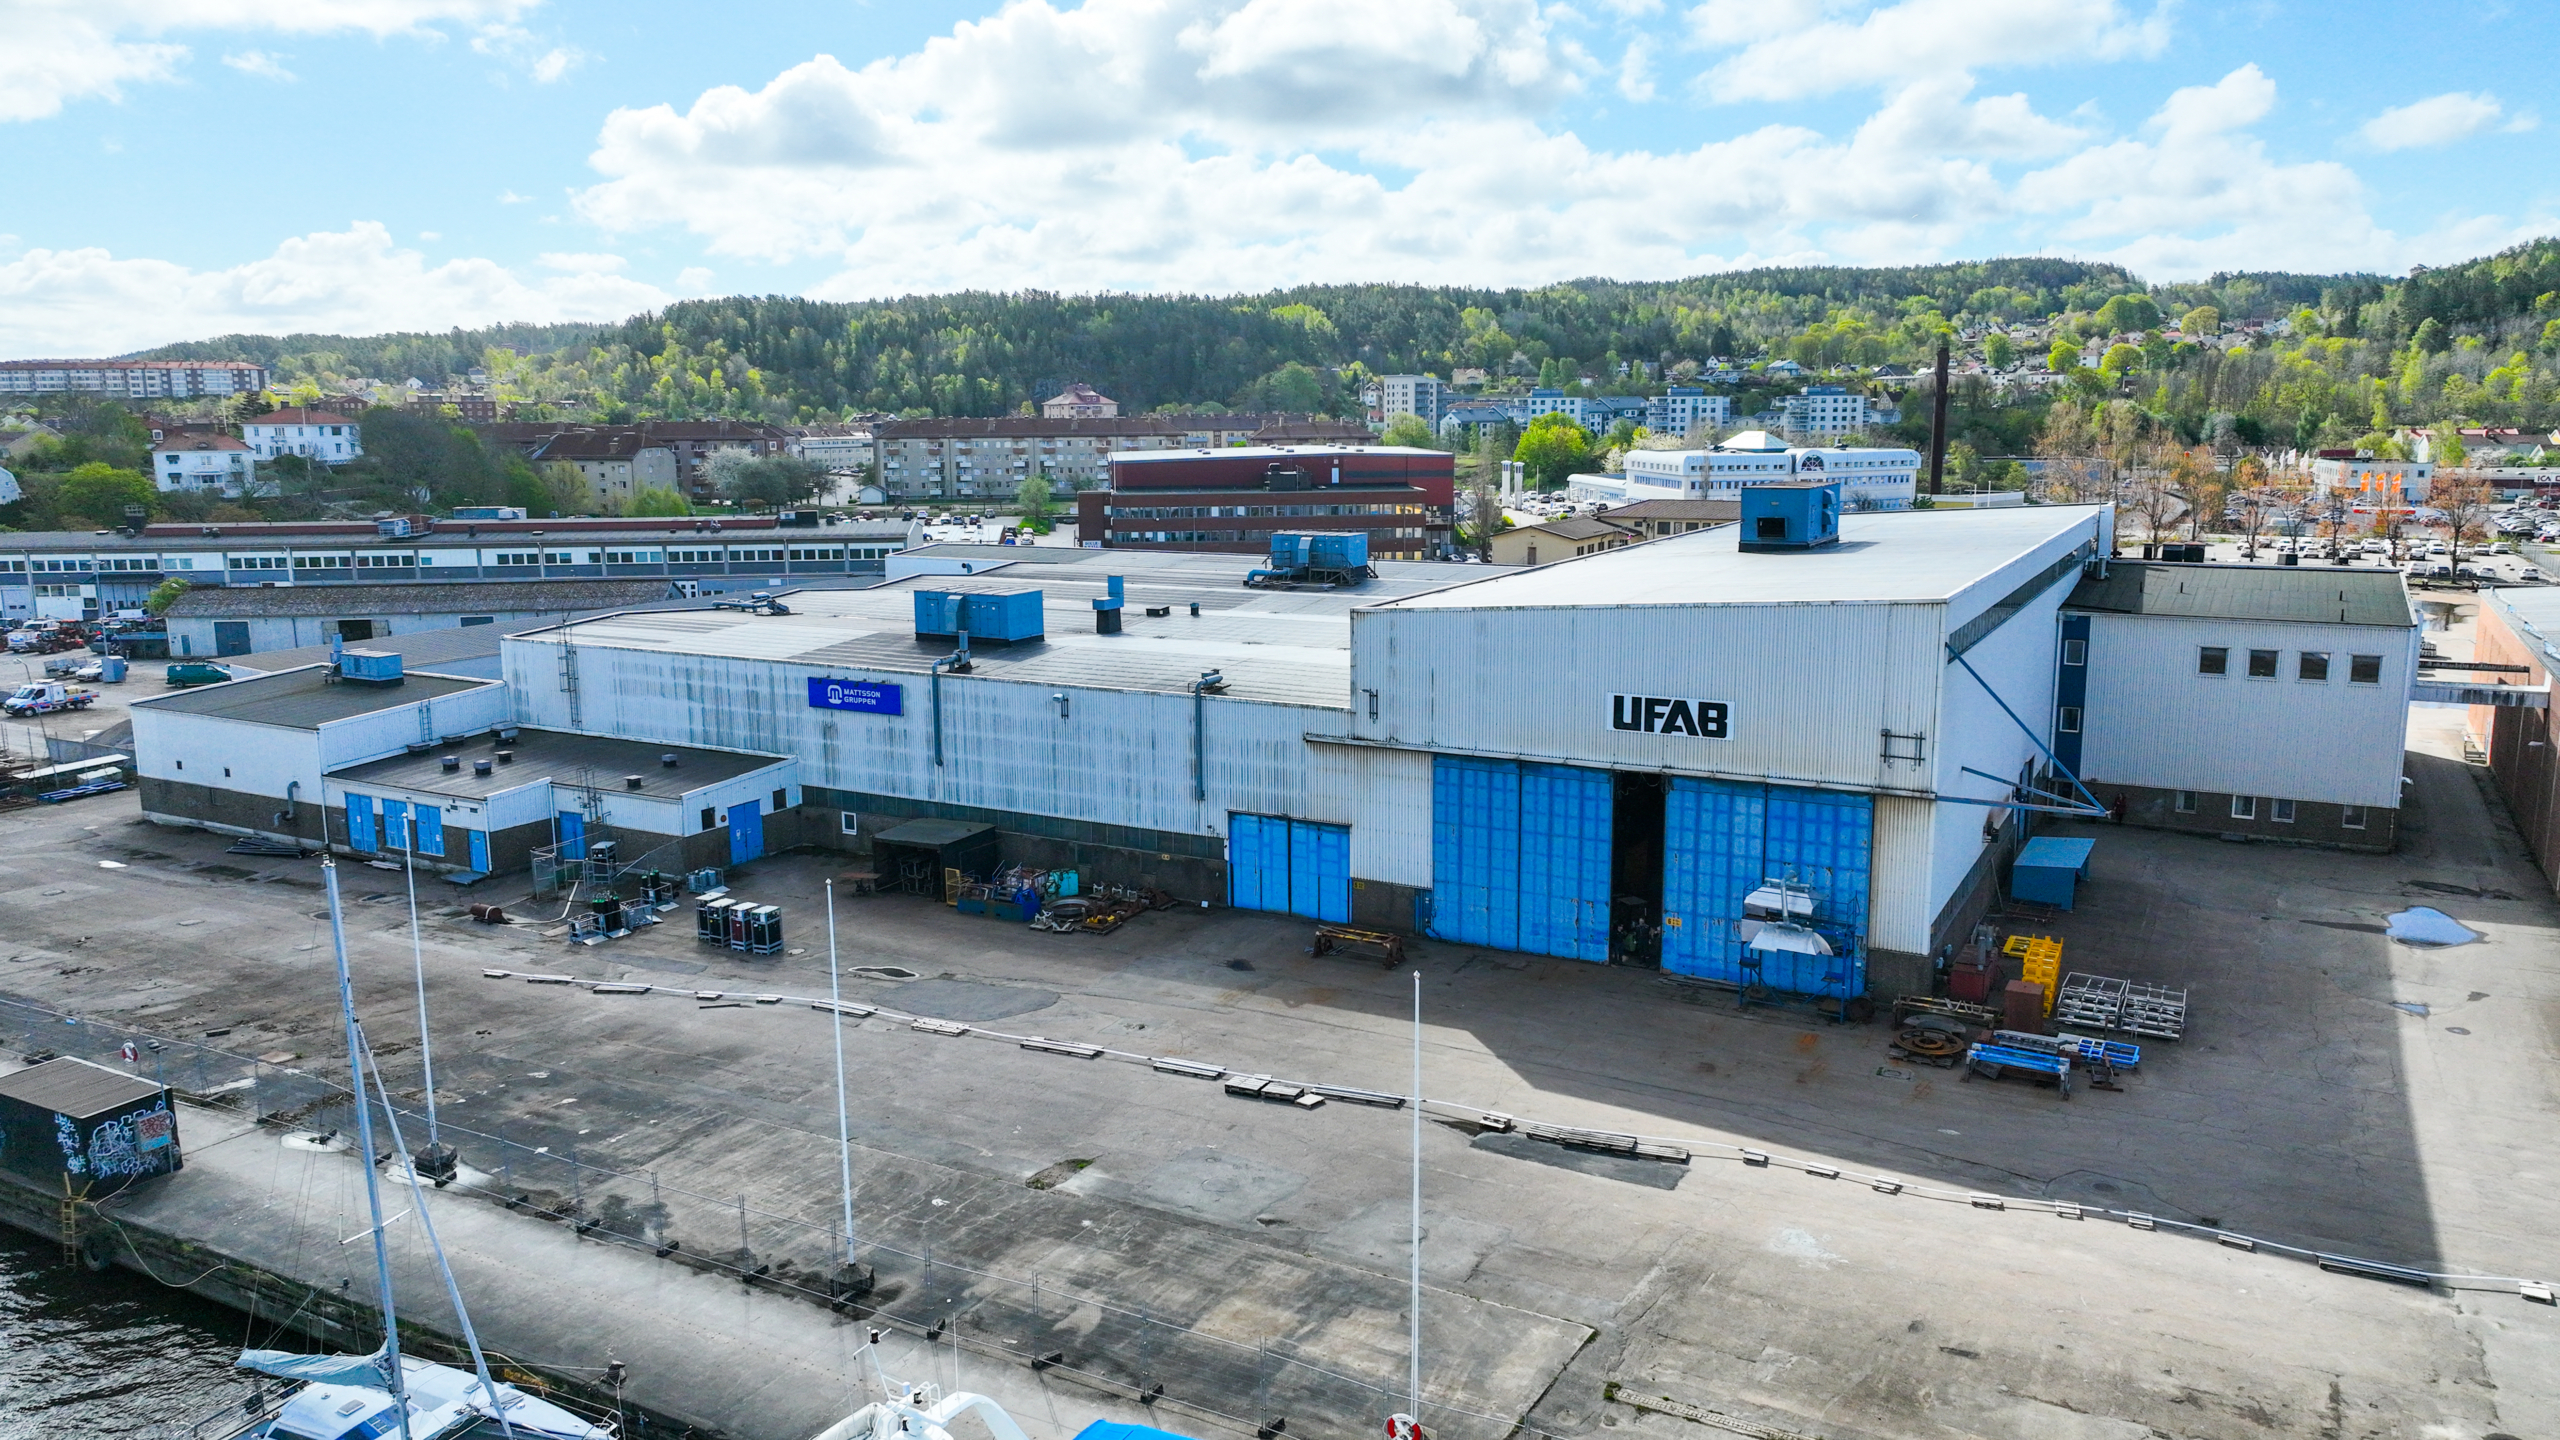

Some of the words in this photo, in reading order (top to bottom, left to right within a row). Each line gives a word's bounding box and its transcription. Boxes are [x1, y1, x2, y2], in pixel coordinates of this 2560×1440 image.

[843, 688, 881, 698] MATTSSON
[843, 696, 877, 705] GRUPPEN
[1613, 695, 1728, 739] UFAB
